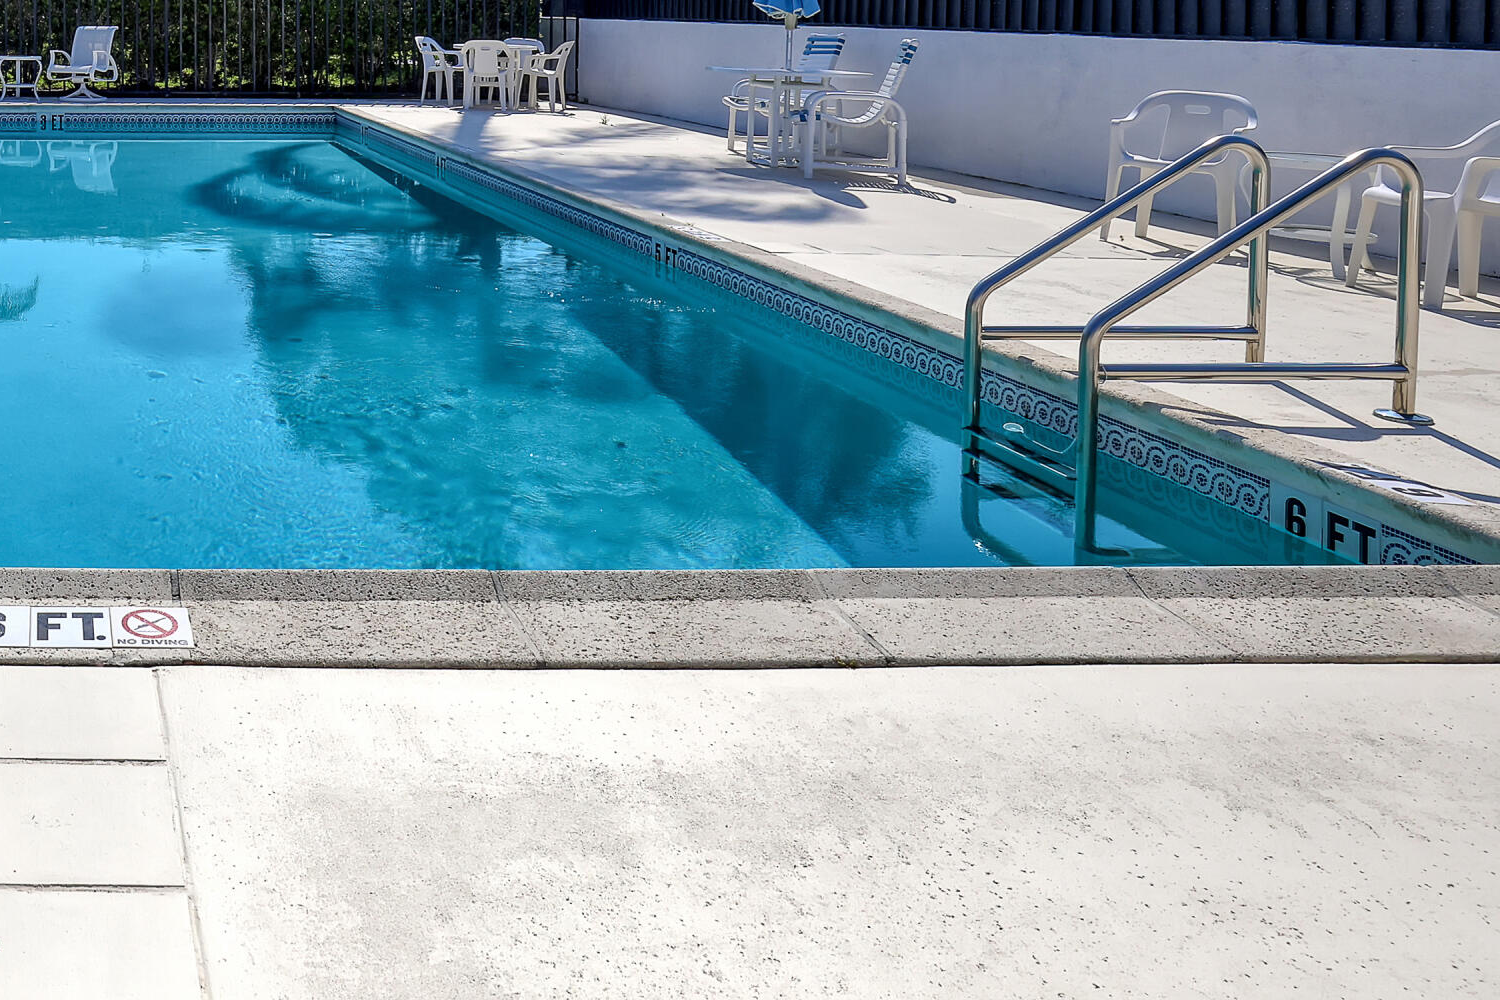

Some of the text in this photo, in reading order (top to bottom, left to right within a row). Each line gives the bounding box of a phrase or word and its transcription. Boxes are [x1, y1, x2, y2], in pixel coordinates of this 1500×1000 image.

[655, 243, 678, 268] 5 FT
[1285, 497, 1307, 537] 6
[36, 612, 107, 641] FT.
[117, 637, 189, 646] NO DIVING
